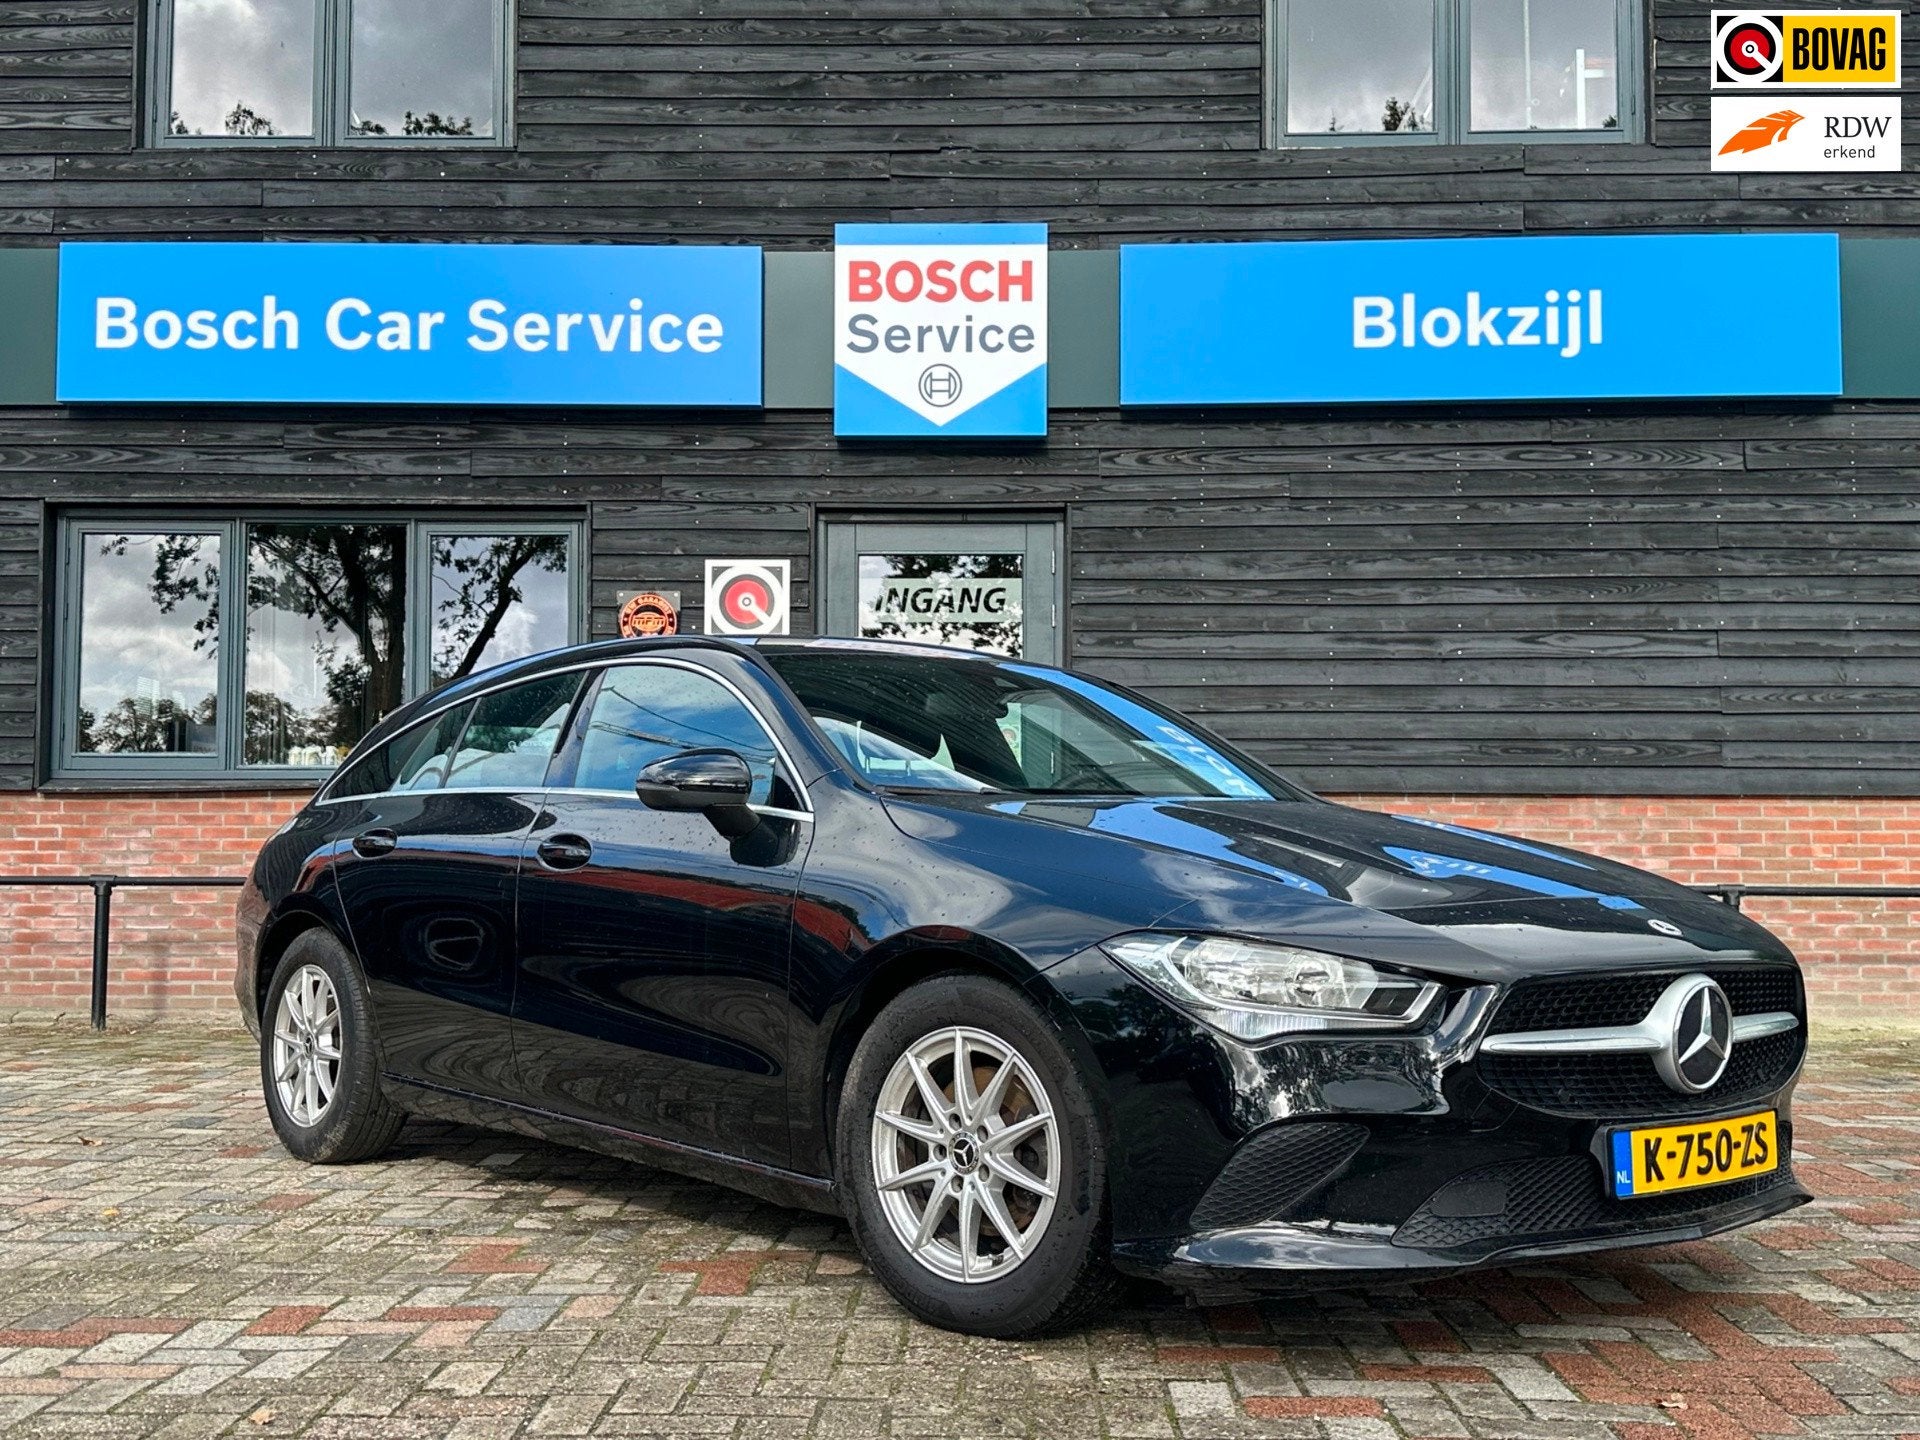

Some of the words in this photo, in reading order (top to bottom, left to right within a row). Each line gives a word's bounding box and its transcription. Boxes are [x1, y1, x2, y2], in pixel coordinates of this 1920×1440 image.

[848, 260, 1033, 303] BOSCH
[95, 295, 299, 350] Bosch
[325, 297, 446, 351] Car
[466, 297, 724, 353] Service
[846, 313, 1035, 354] Service
[1352, 289, 1602, 358] Blokzijl
[875, 587, 1007, 613] INGANG
[1643, 1121, 1769, 1184] K-750-ZS
[1616, 1170, 1631, 1184] NL
